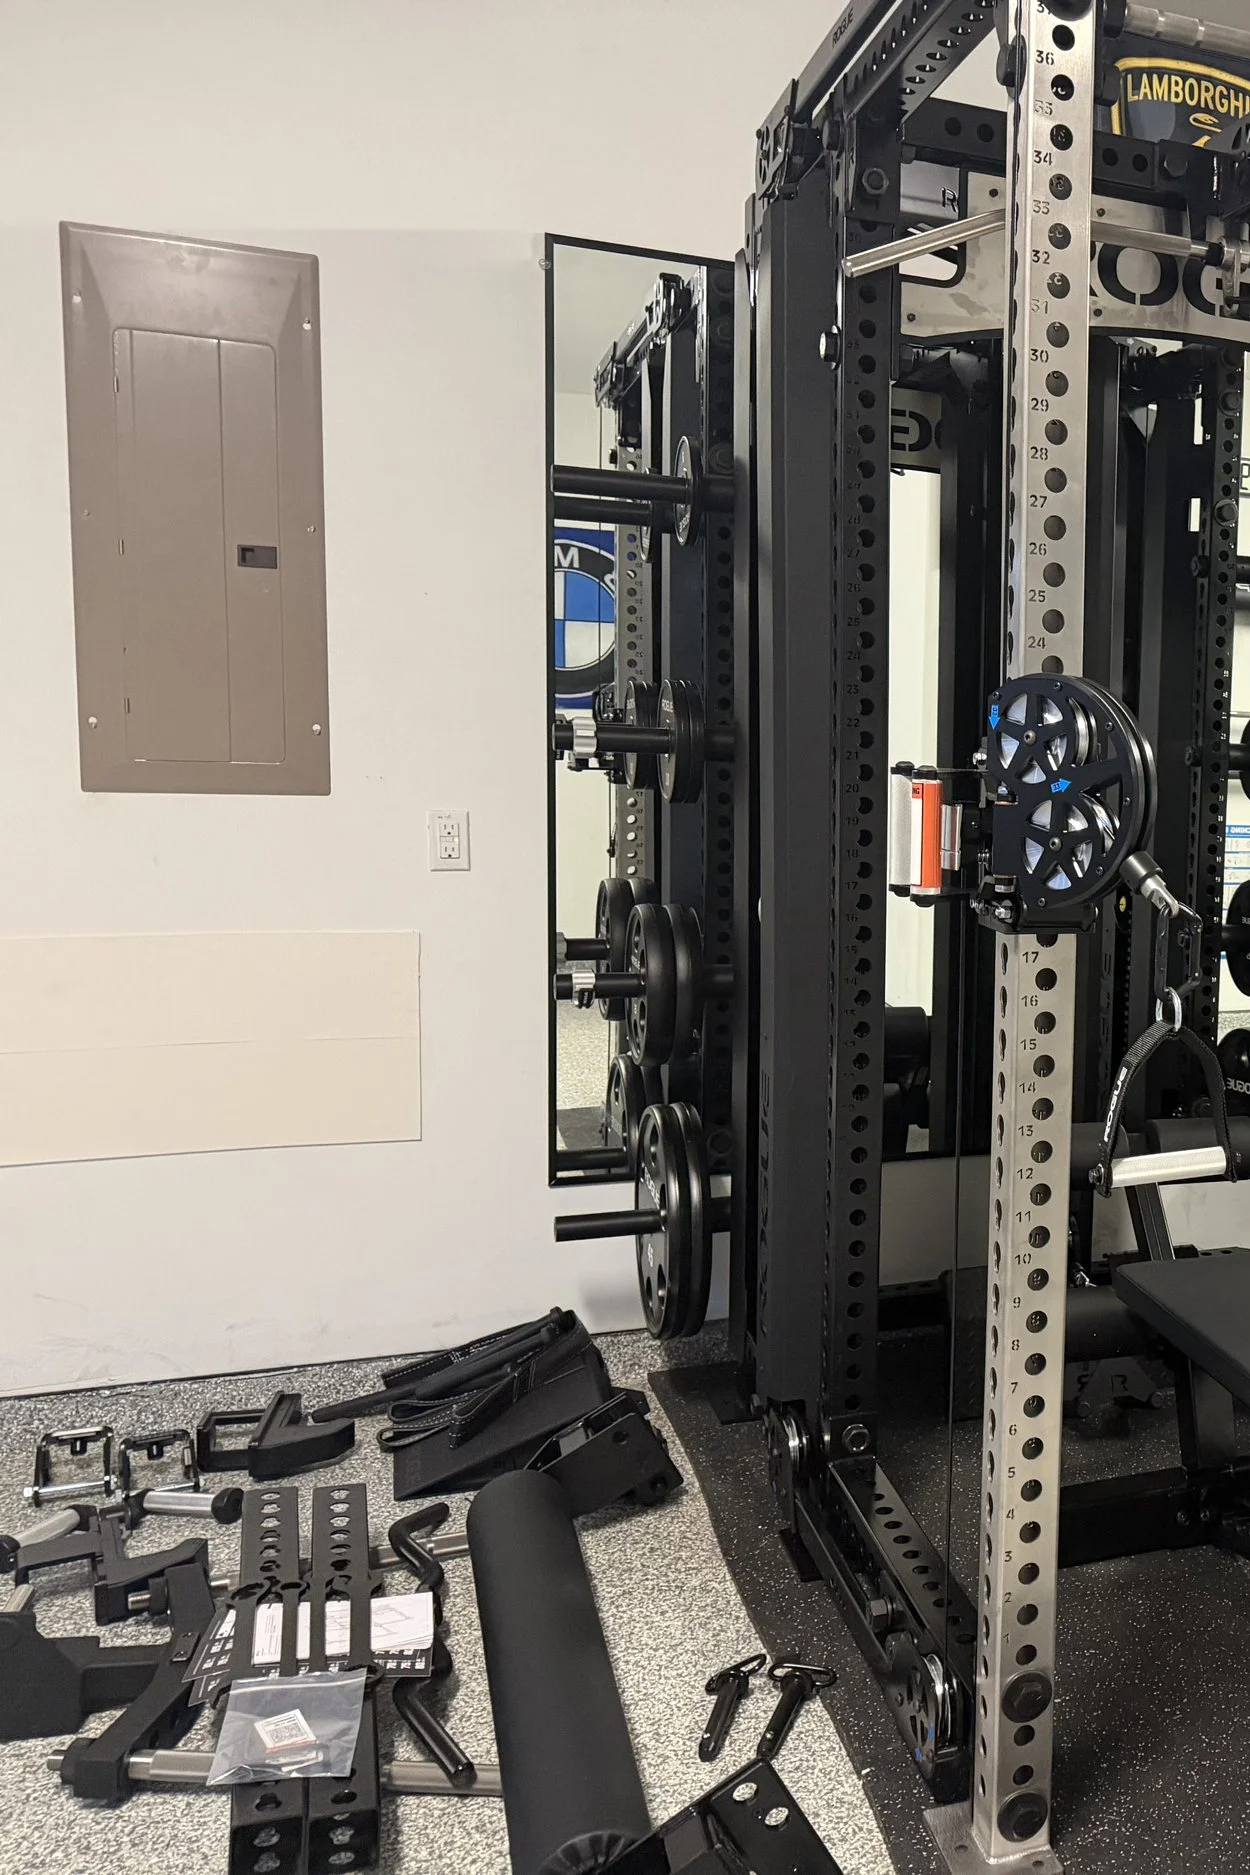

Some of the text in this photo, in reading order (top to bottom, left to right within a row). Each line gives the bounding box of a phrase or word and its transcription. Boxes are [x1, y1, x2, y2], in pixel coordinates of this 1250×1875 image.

[1036, 50, 1055, 66] 36
[1034, 100, 1053, 116] 35
[1034, 151, 1052, 165] 34
[1033, 200, 1050, 215] 33
[1032, 250, 1050, 264] 32
[1031, 299, 1048, 314] 31
[1030, 348, 1049, 363] 30
[1031, 398, 1049, 412] 29
[1030, 447, 1048, 460] 28
[1030, 495, 1047, 508] 27
[1029, 542, 1047, 556] 26
[1028, 590, 1046, 602] 25
[1028, 636, 1046, 649] 24
[1022, 951, 1039, 963] 17
[1021, 995, 1038, 1006] 16
[1020, 1039, 1037, 1050] 15
[1019, 1081, 1036, 1094] 14
[1104, 1066, 1128, 1142] ROGUE
[1018, 1124, 1034, 1137] 13
[1016, 1168, 1034, 1180] 12
[1016, 1210, 1032, 1222] 11
[1015, 1252, 1031, 1265] 10
[1013, 1296, 1020, 1308] 9
[1012, 1339, 1020, 1351] 8
[1010, 1382, 1018, 1394] 7
[1009, 1424, 1017, 1436] 6
[1008, 1466, 1016, 1478] 5
[1006, 1509, 1015, 1520] 4
[1005, 1551, 1012, 1562] 3
[1004, 1592, 1012, 1603] 2
[1004, 1633, 1009, 1643] 1
